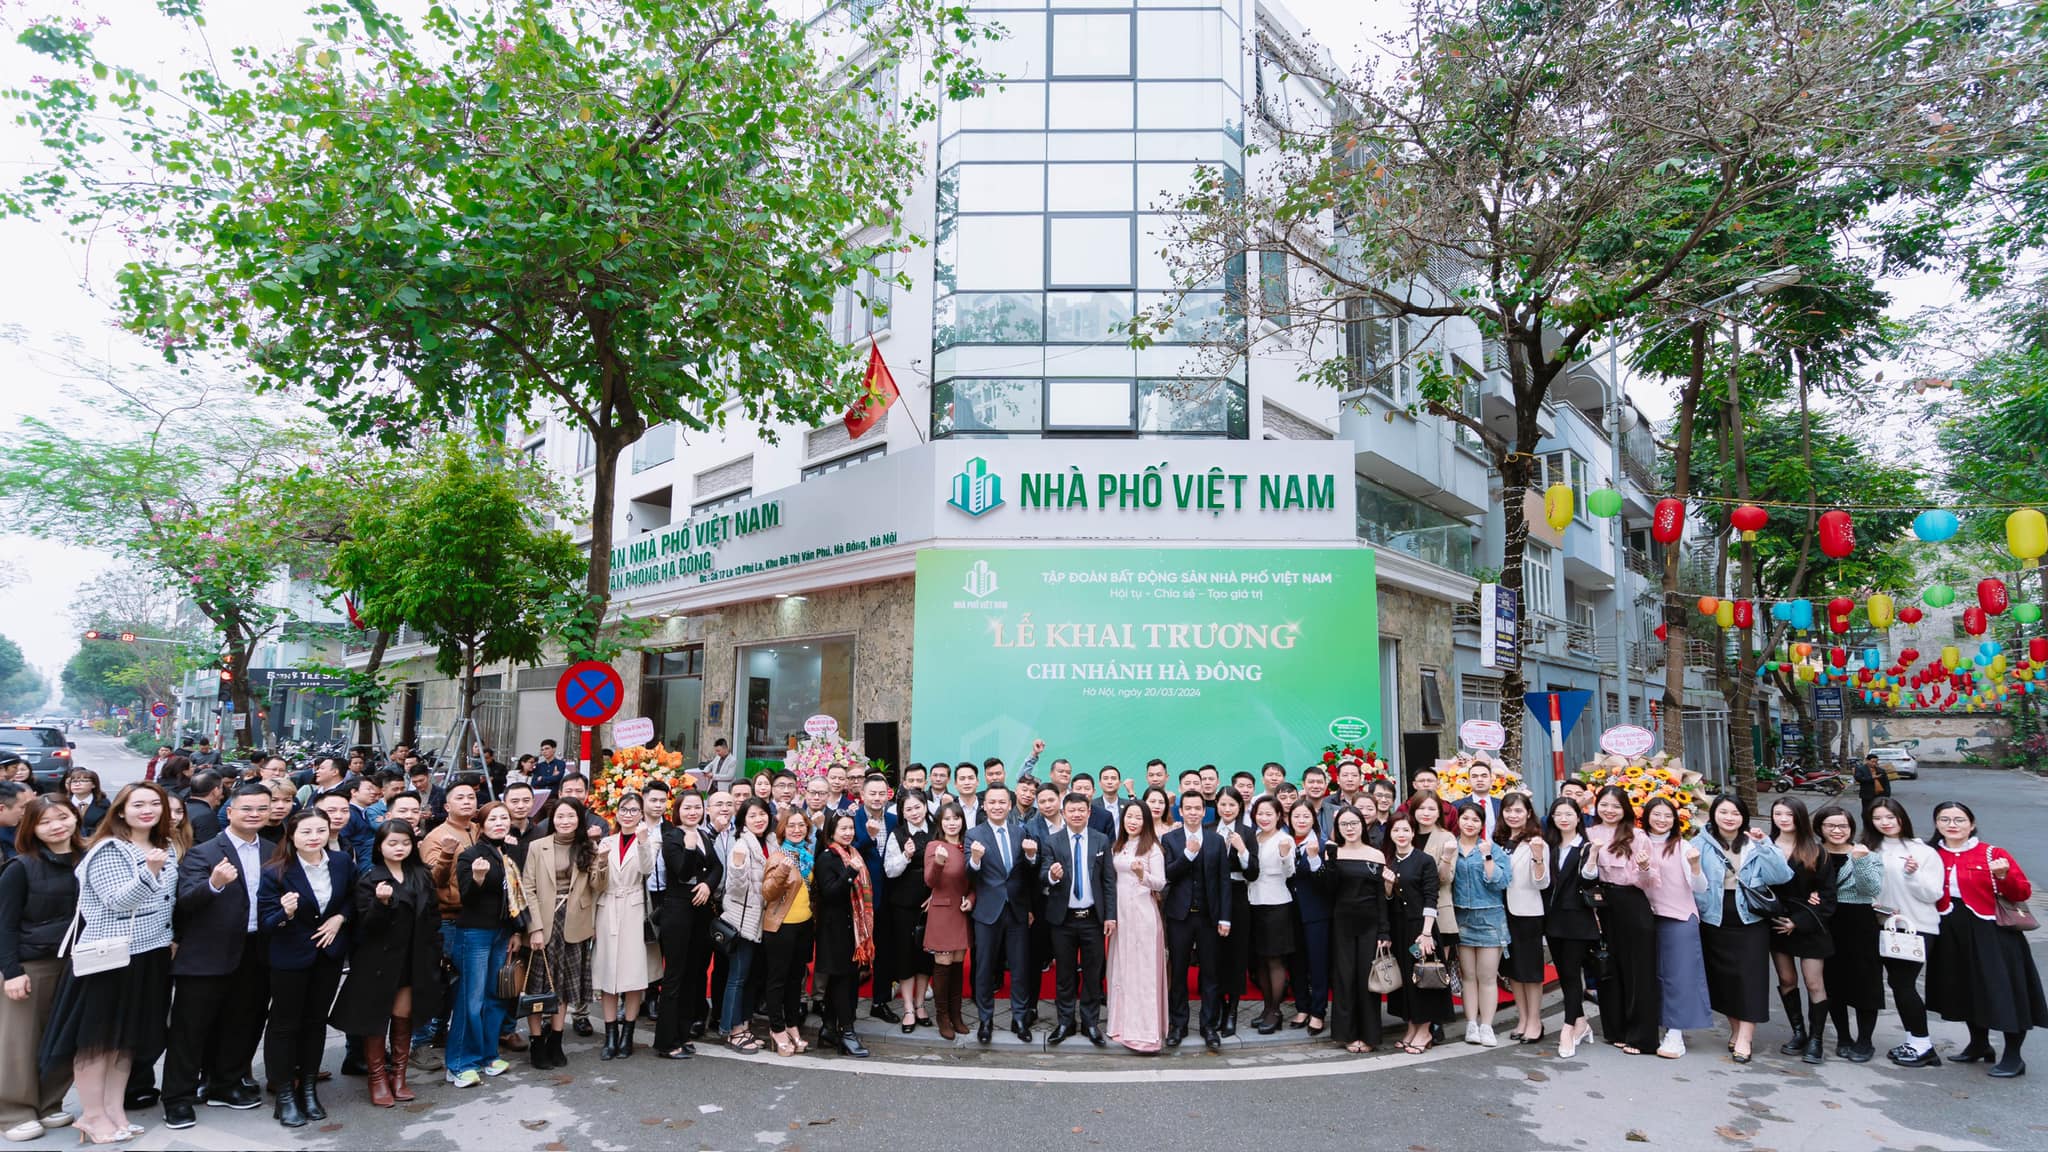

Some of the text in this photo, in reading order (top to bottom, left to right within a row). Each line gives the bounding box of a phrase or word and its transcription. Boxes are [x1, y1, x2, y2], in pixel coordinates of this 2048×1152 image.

[1020, 461, 1335, 518] NHÀ PHỐ VIỆT NAM
[629, 533, 657, 565] NHÀ
[661, 517, 692, 556] PHỐ
[695, 513, 730, 548] VIỆT
[735, 500, 779, 536] NAM
[1041, 569, 1066, 585] TẬP
[1068, 569, 1108, 584] ĐOÀN
[1110, 568, 1135, 584] BẤT
[1137, 568, 1178, 586] ĐỘNG
[1209, 569, 1238, 584] NHÀ
[1241, 568, 1269, 584] PHỐ
[1271, 569, 1300, 587] VIỆT
[1302, 572, 1333, 584] NAM
[1153, 588, 1180, 599] Chia
[1045, 622, 1136, 650] KHAI
[1142, 621, 1297, 650] TRƯƠNG
[1026, 659, 1263, 682] CHI NHÁNH HÀ ĐÔNG
[1118, 687, 1142, 699] ngày
[1144, 686, 1201, 698] 20/03/2024
